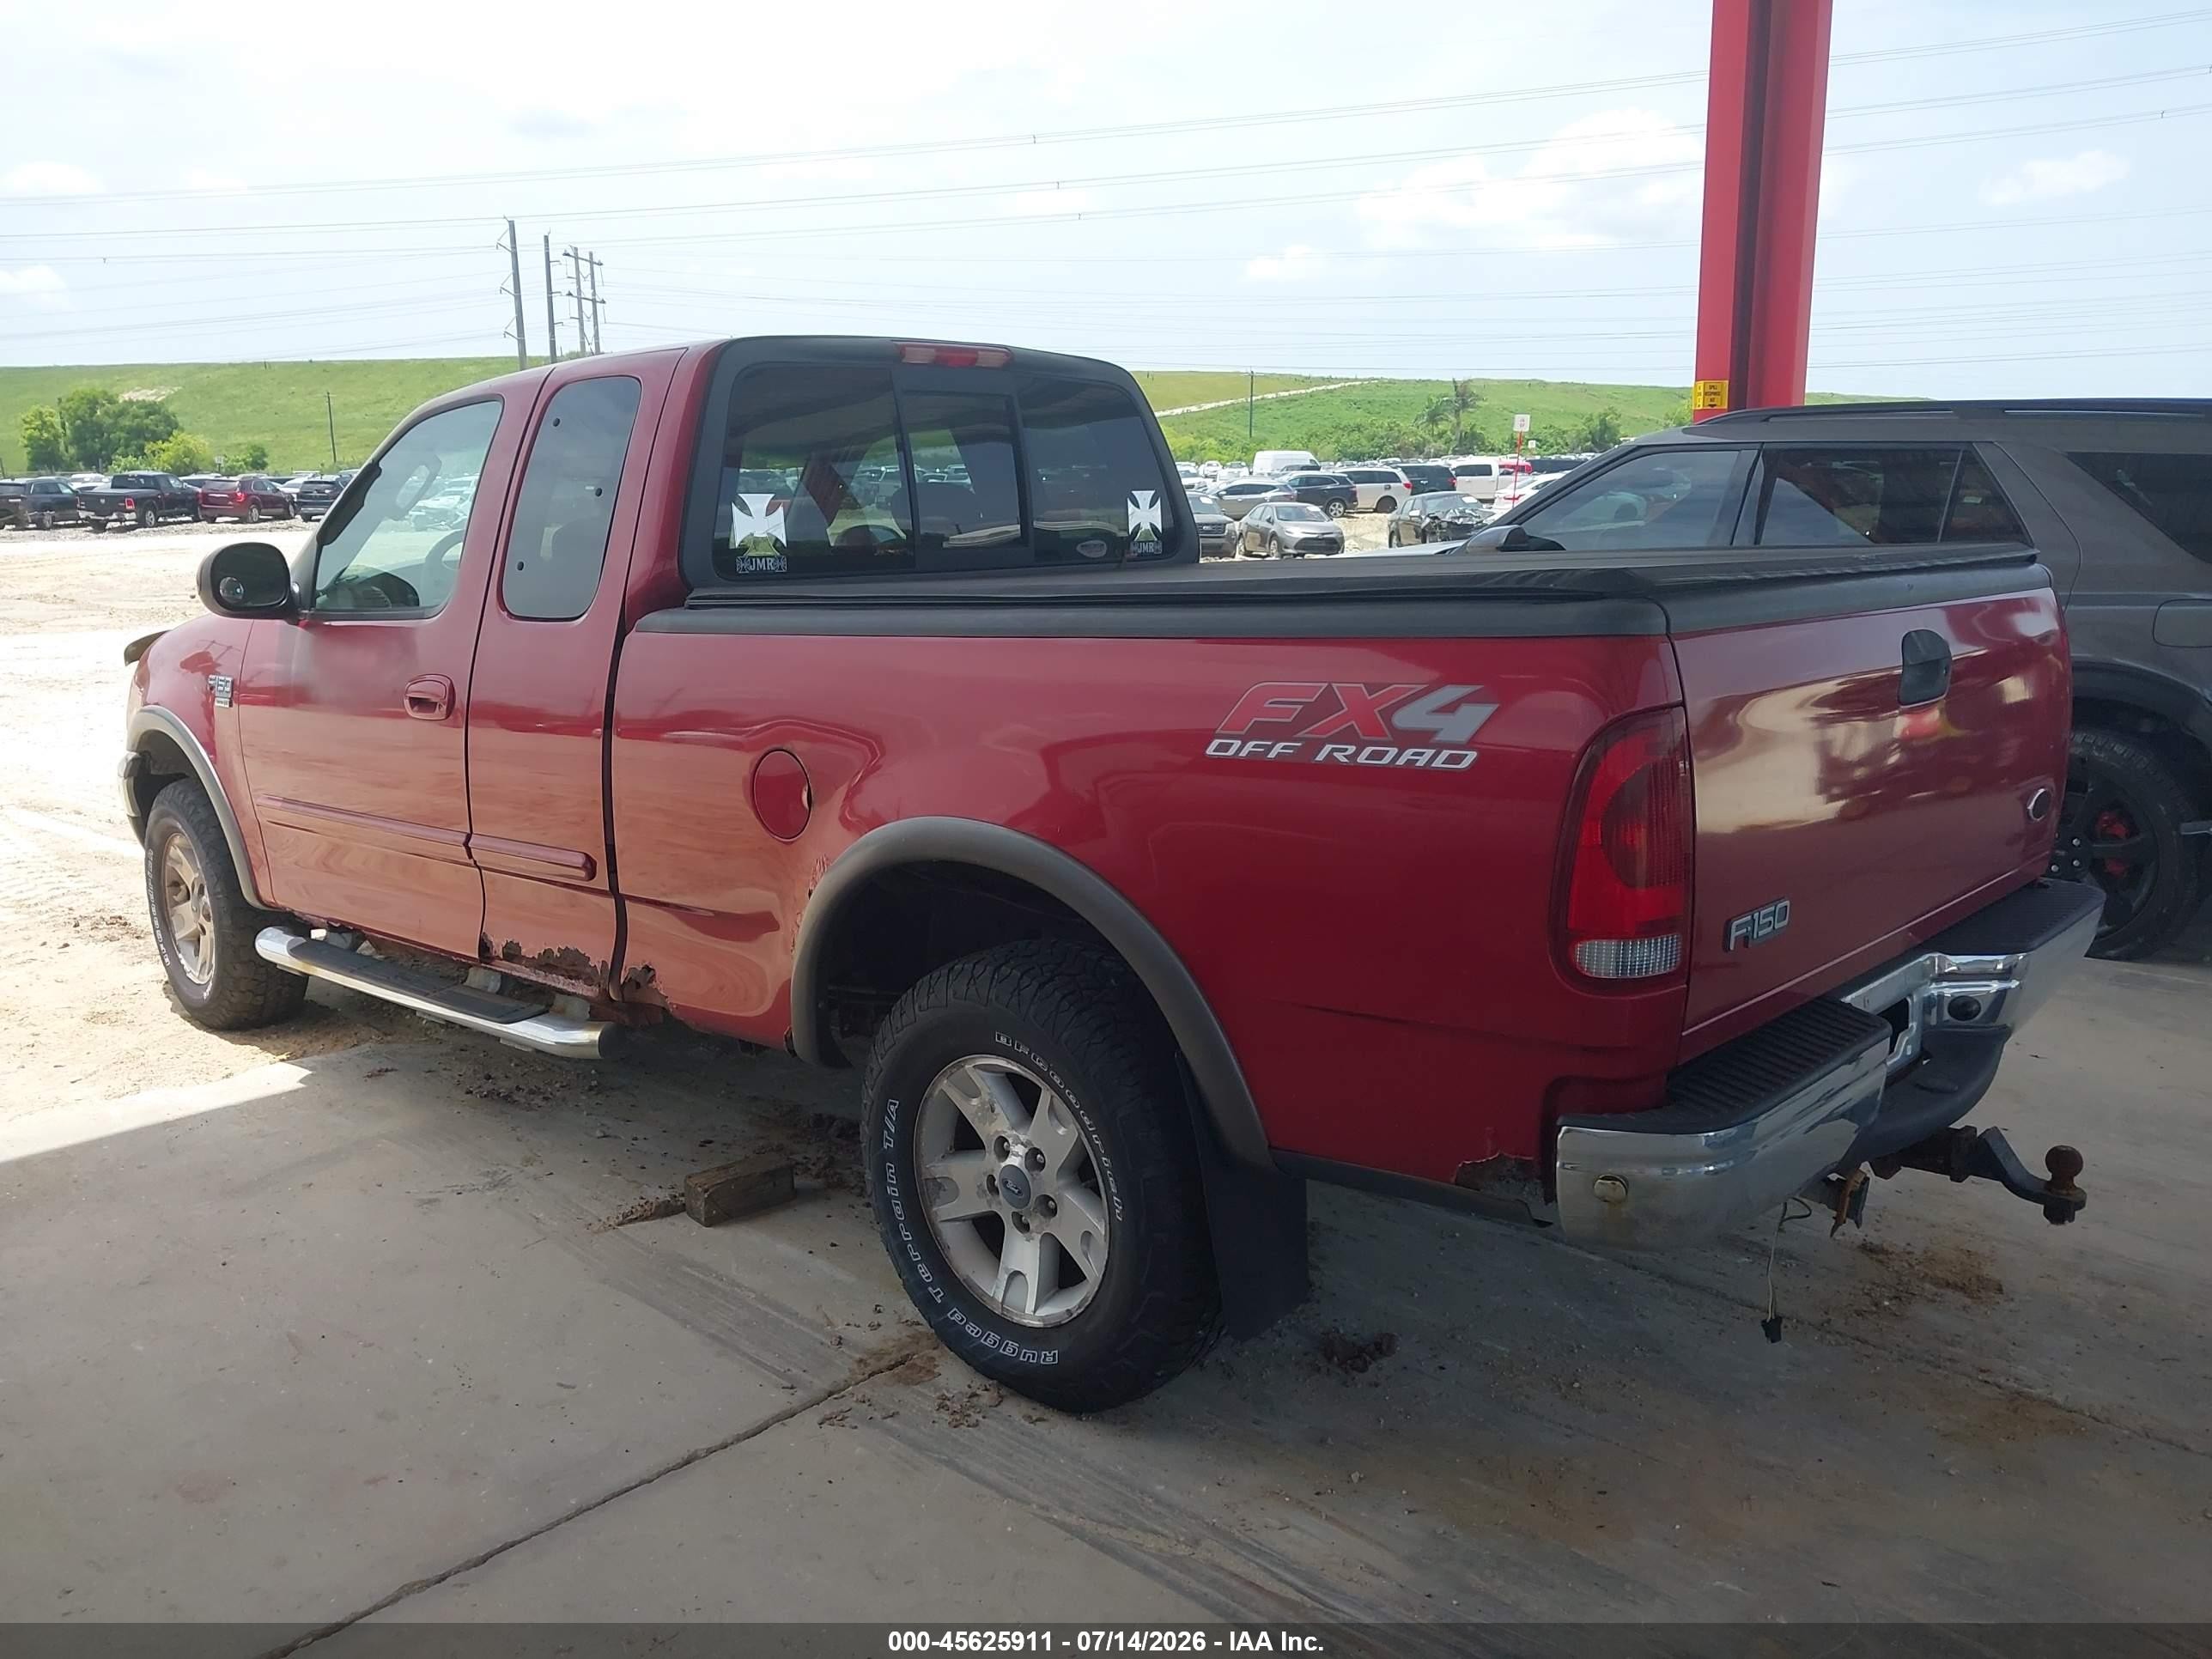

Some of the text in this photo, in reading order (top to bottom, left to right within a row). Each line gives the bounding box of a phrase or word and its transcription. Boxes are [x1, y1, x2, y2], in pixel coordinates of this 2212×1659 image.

[1138, 542, 1154, 553] JMR
[749, 557, 775, 571] JMR
[1214, 680, 1500, 745] FX4
[1205, 738, 1479, 769] OFF ROAD
[882, 1098, 1060, 1365] Rugged Terrain T/A
